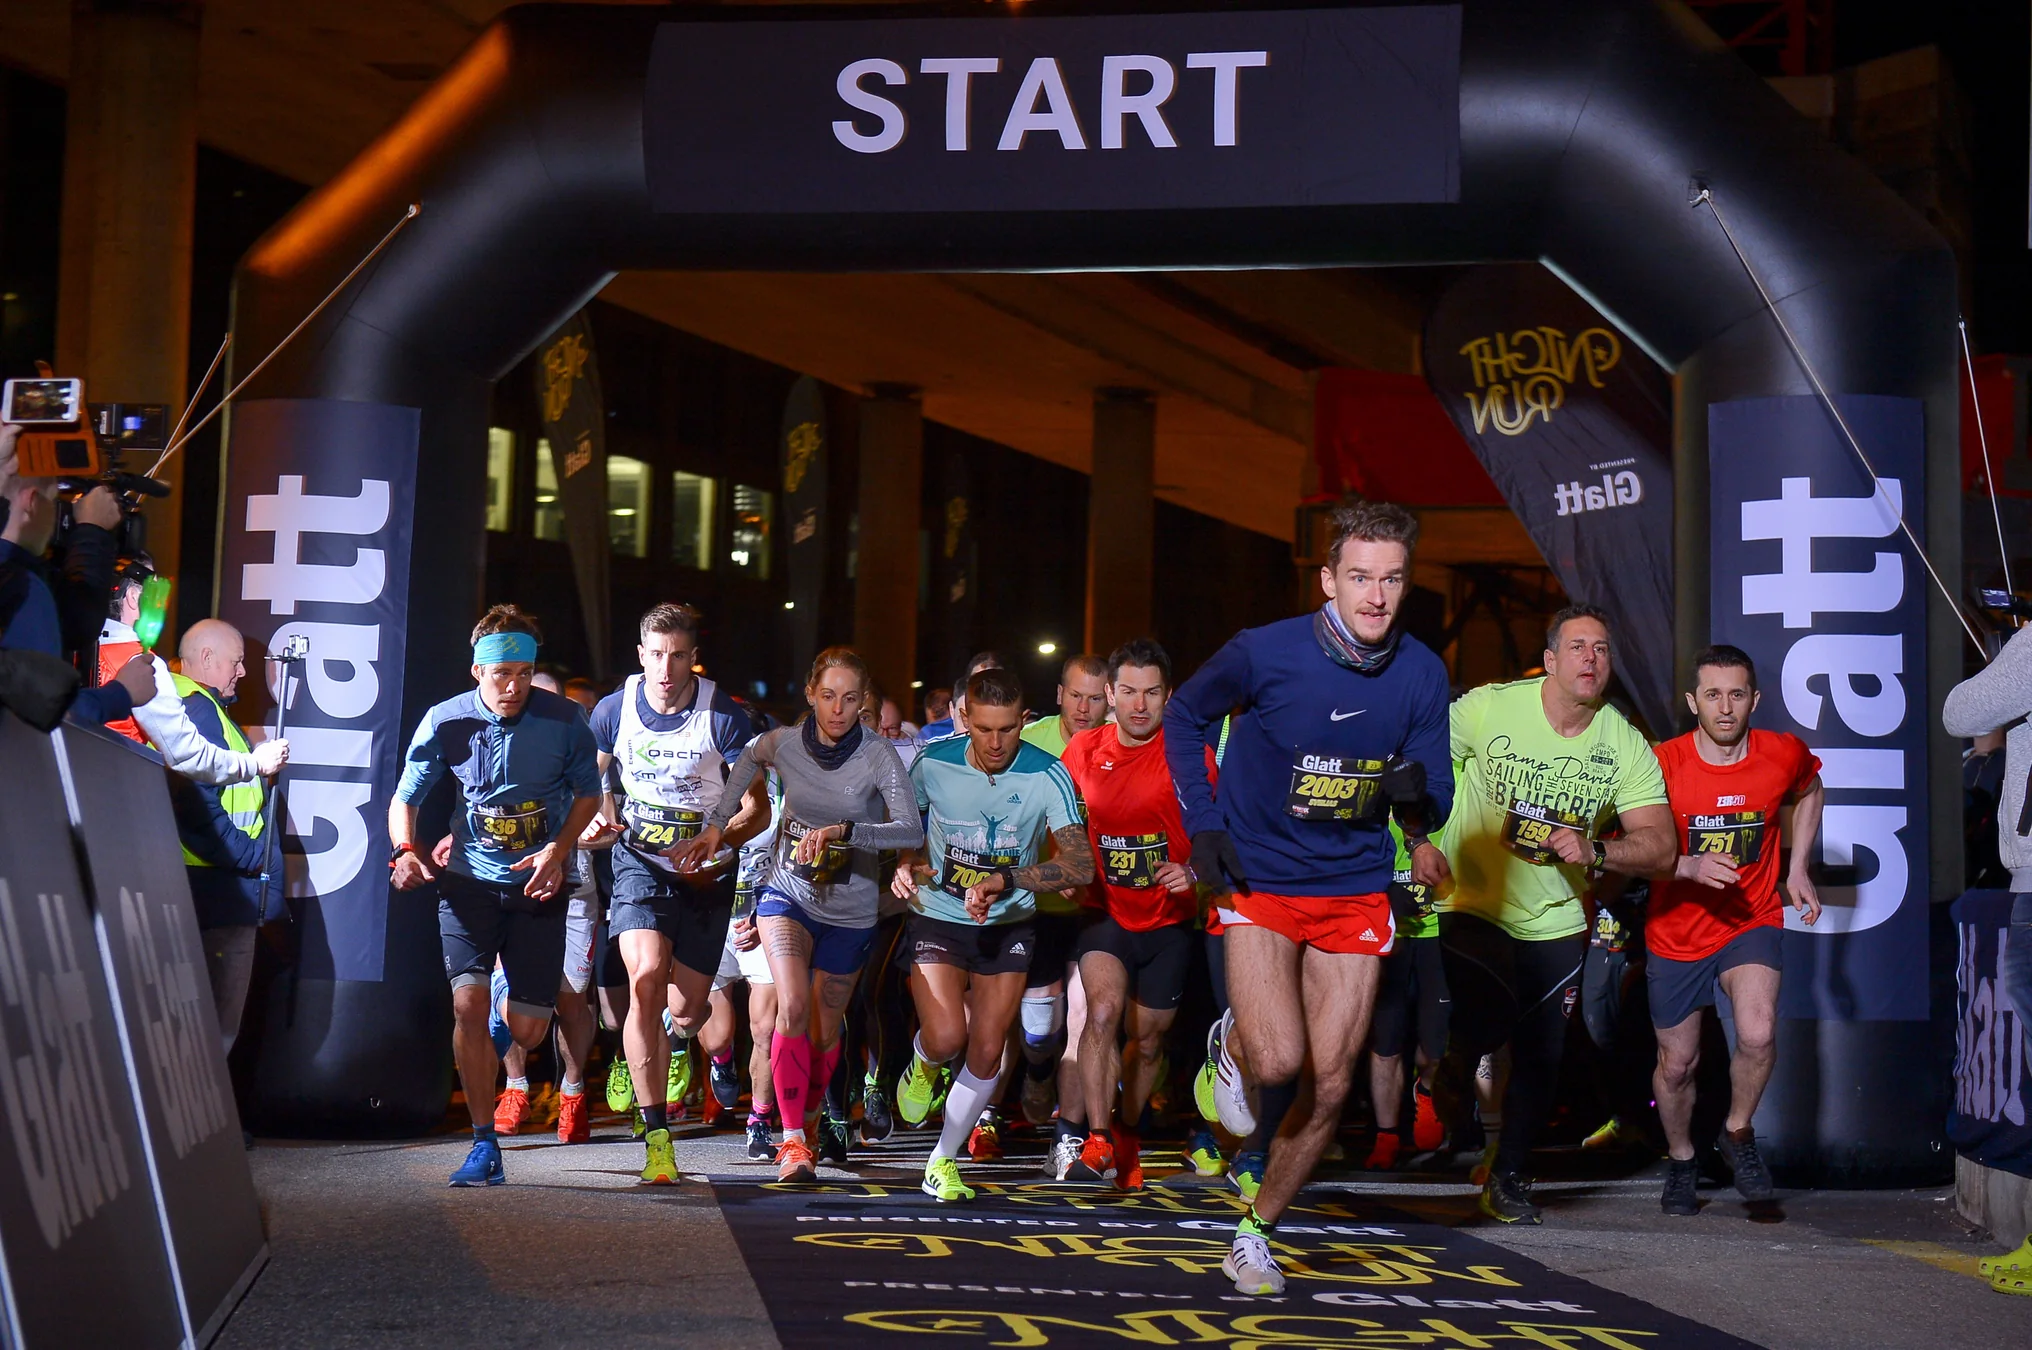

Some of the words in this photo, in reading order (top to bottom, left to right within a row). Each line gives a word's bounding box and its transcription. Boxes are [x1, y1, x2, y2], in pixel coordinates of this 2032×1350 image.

[832, 50, 1267, 154] START
[241, 475, 391, 898] Glatt
[1741, 476, 1909, 933] Glatt
[1302, 755, 1343, 773] Glatt
[1487, 735, 1554, 771] Camp
[1553, 756, 1619, 785] David
[1296, 775, 1358, 799] 2003
[1486, 759, 1544, 791] SAILING
[1545, 775, 1559, 793] THE
[1560, 780, 1592, 797] SEVEN
[638, 805, 665, 820] Glatt
[1515, 800, 1547, 820] Glatt
[1695, 815, 1725, 827] Glatt
[484, 817, 517, 835] 336
[638, 822, 675, 845] 724
[1516, 819, 1552, 843] 159
[1101, 835, 1127, 848] Glatt
[1698, 832, 1735, 853] 751
[951, 847, 979, 865] Glatt
[1110, 851, 1136, 869] 231
[796, 1216, 1079, 1226] PRESENTED
[1177, 1220, 1406, 1237] Gatt
[1094, 1252, 1523, 1287] RUN
[844, 1281, 1194, 1298] PRESENTED
[1220, 1295, 1290, 1303] BY
[1311, 1292, 1597, 1314] Glatt
